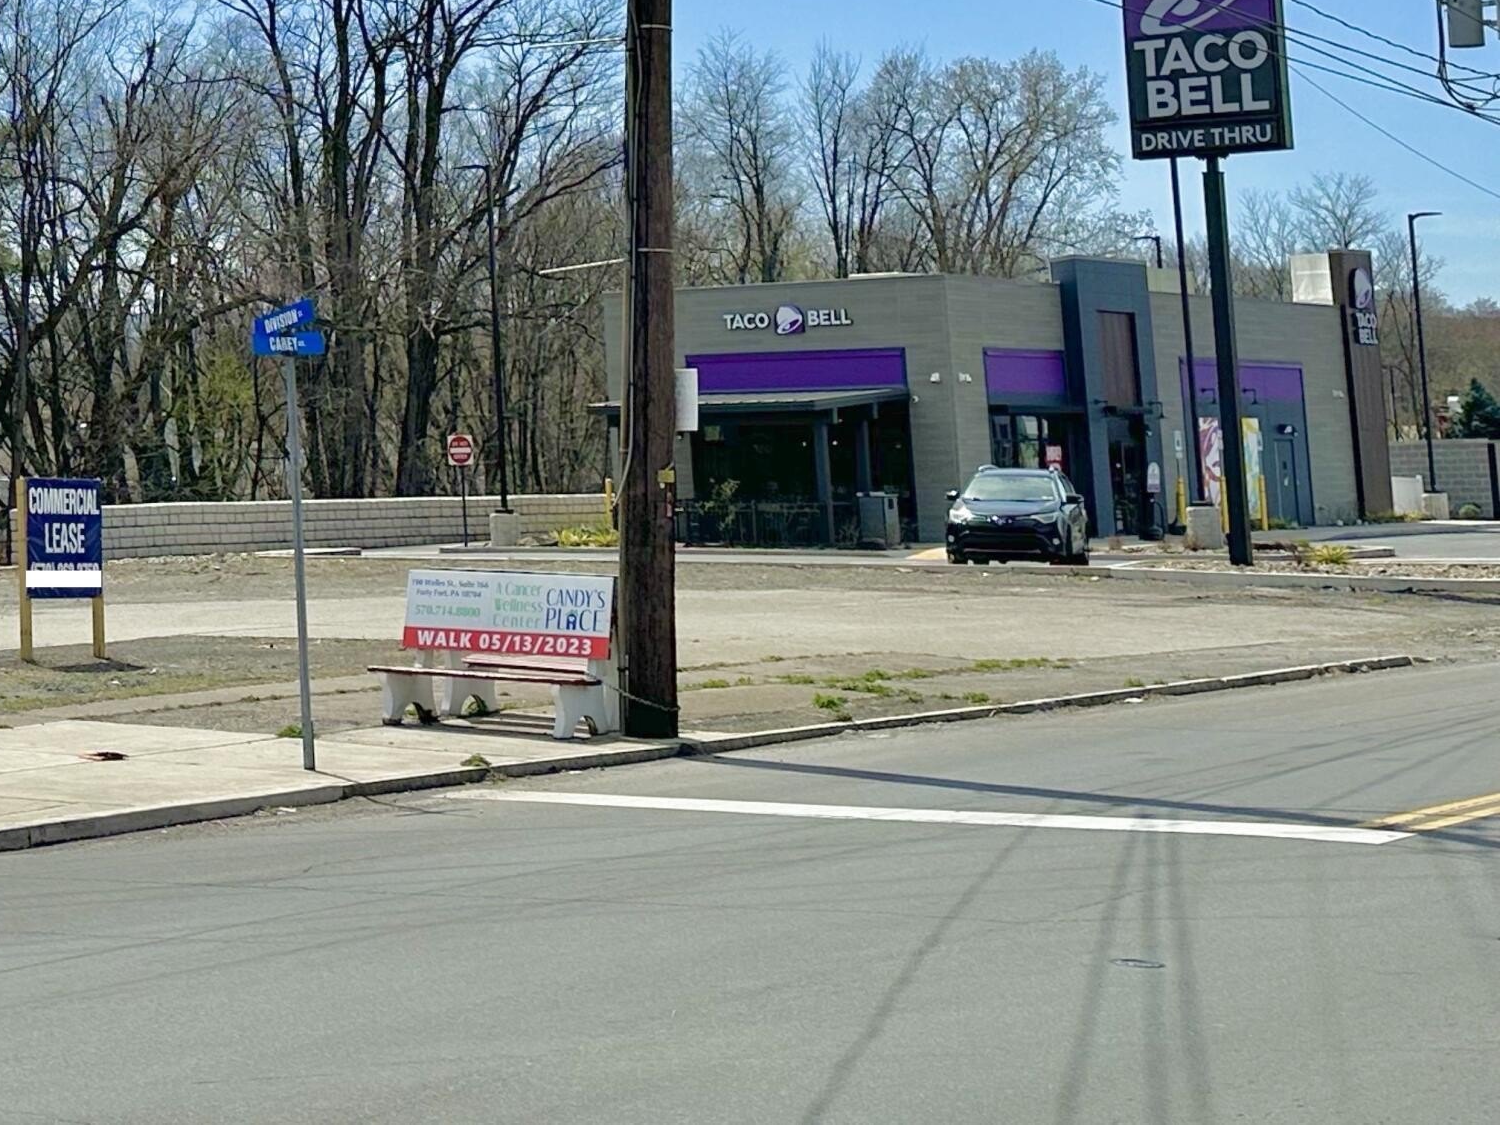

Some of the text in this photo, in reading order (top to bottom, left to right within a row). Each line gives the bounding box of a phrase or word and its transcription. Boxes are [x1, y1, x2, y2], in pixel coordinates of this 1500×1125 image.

[1133, 30, 1269, 77] TACO
[1146, 73, 1270, 118] BELL
[1141, 125, 1272, 151] DRIVE THRU
[723, 308, 852, 330] TACO BELL
[1355, 312, 1377, 329] TACO
[269, 336, 298, 352] CAREY
[1358, 328, 1379, 345] BELL
[29, 486, 100, 515] COMMERCIAL
[44, 522, 85, 554] LEASE
[505, 581, 542, 596] Cancer
[546, 588, 606, 608] CANDY'S
[494, 598, 544, 613] Wellness
[493, 613, 541, 629] Center
[545, 607, 605, 632] PLACE
[417, 630, 592, 655] WALK 05/13/2023
